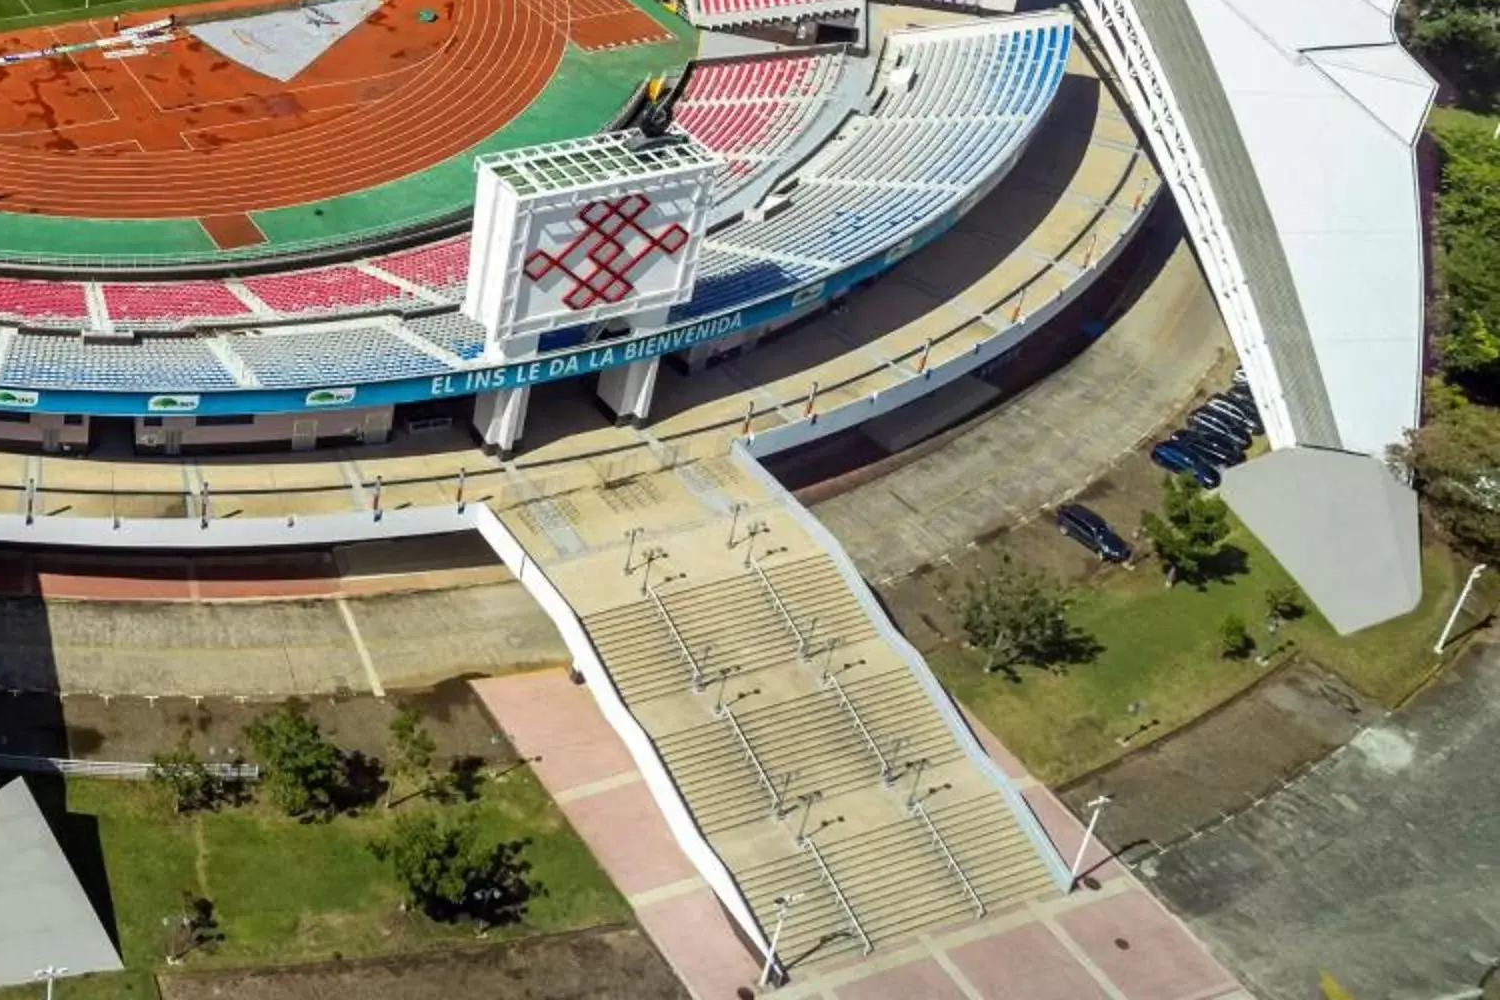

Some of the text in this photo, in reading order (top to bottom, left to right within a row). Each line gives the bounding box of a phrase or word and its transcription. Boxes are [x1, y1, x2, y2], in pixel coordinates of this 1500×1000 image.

[431, 312, 742, 395] EL INS LE DA LA BIENVENIDA
